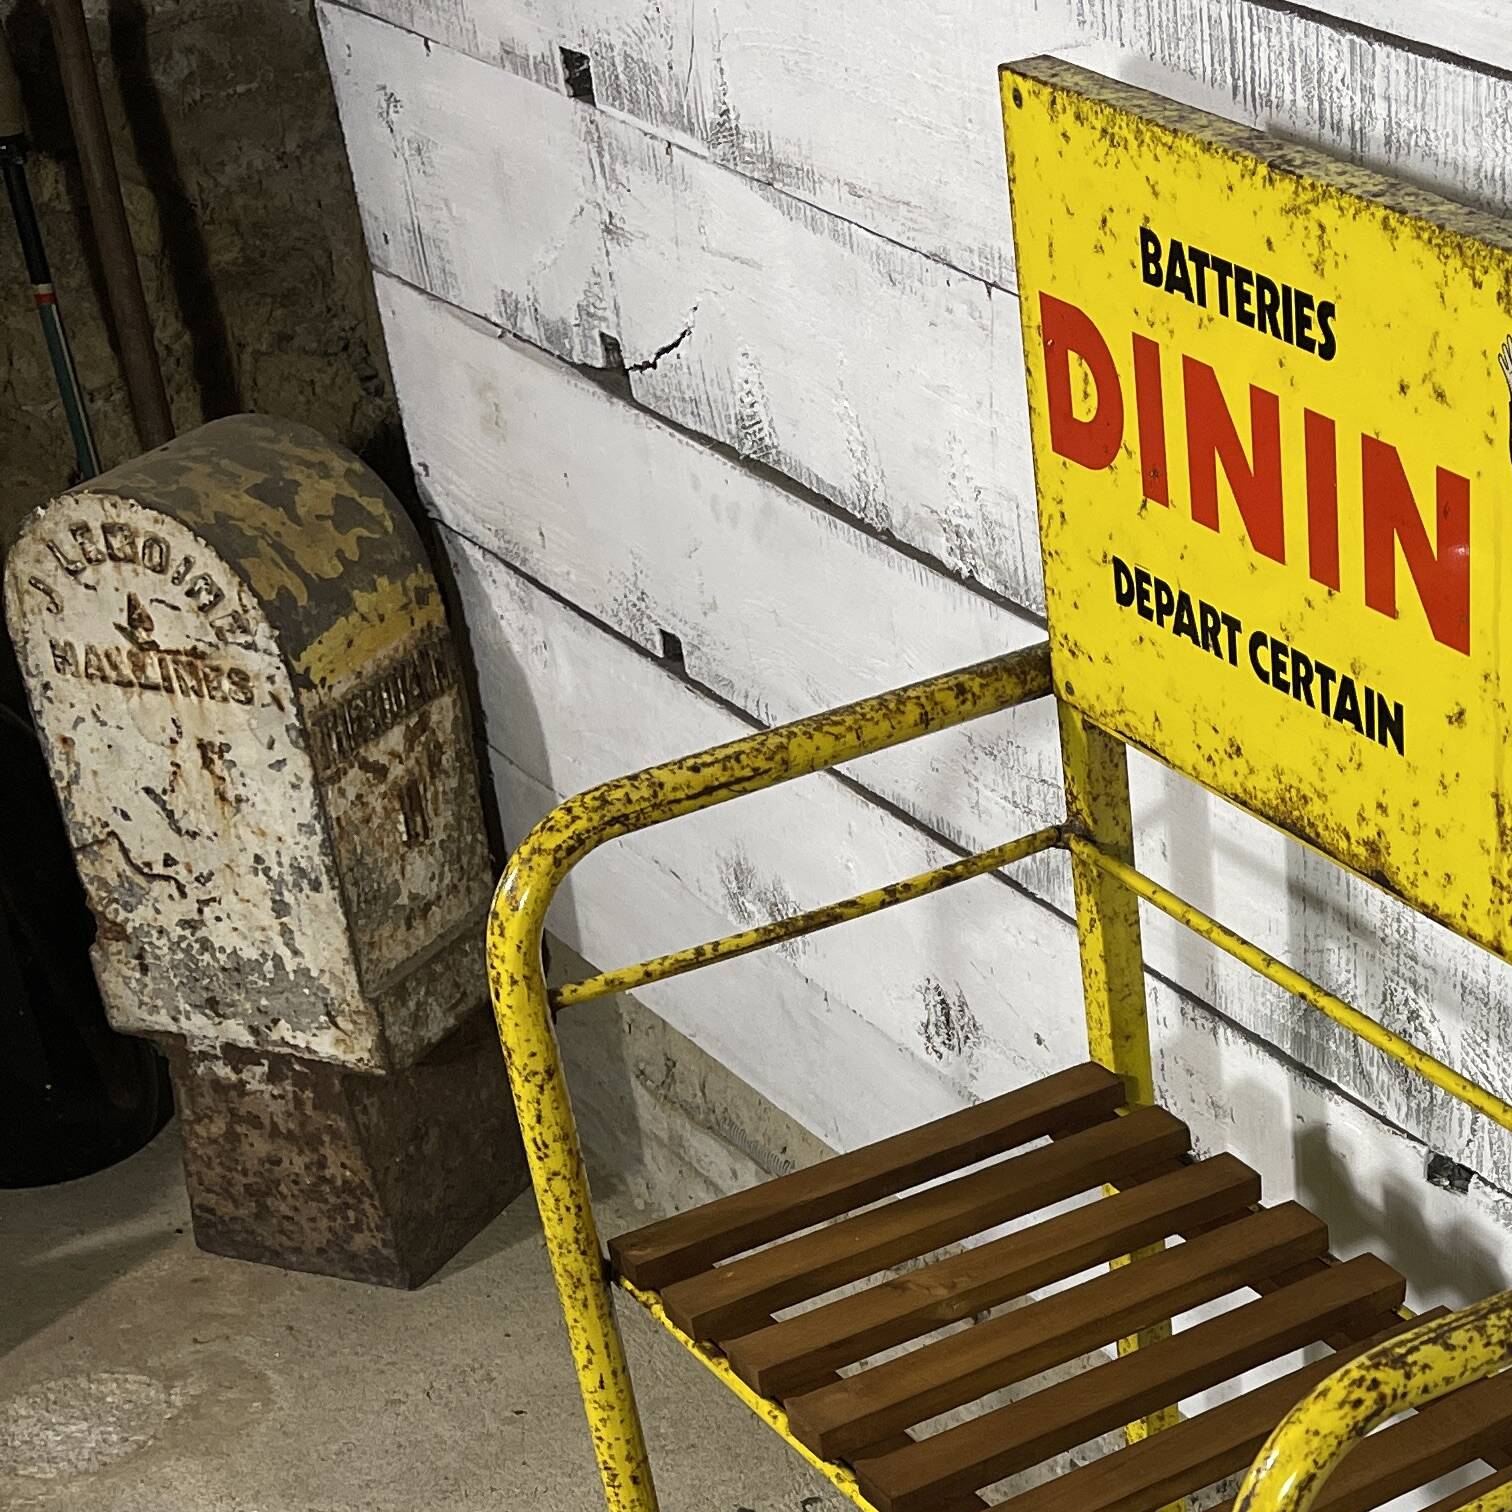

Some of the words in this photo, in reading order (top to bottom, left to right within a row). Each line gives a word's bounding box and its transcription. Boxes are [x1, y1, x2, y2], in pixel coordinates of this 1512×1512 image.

[1139, 226, 1337, 361] BATTERIES
[1039, 290, 1471, 657] DININ
[1112, 555, 1242, 667] DEPART
[1248, 630, 1405, 757] CERTAIN
